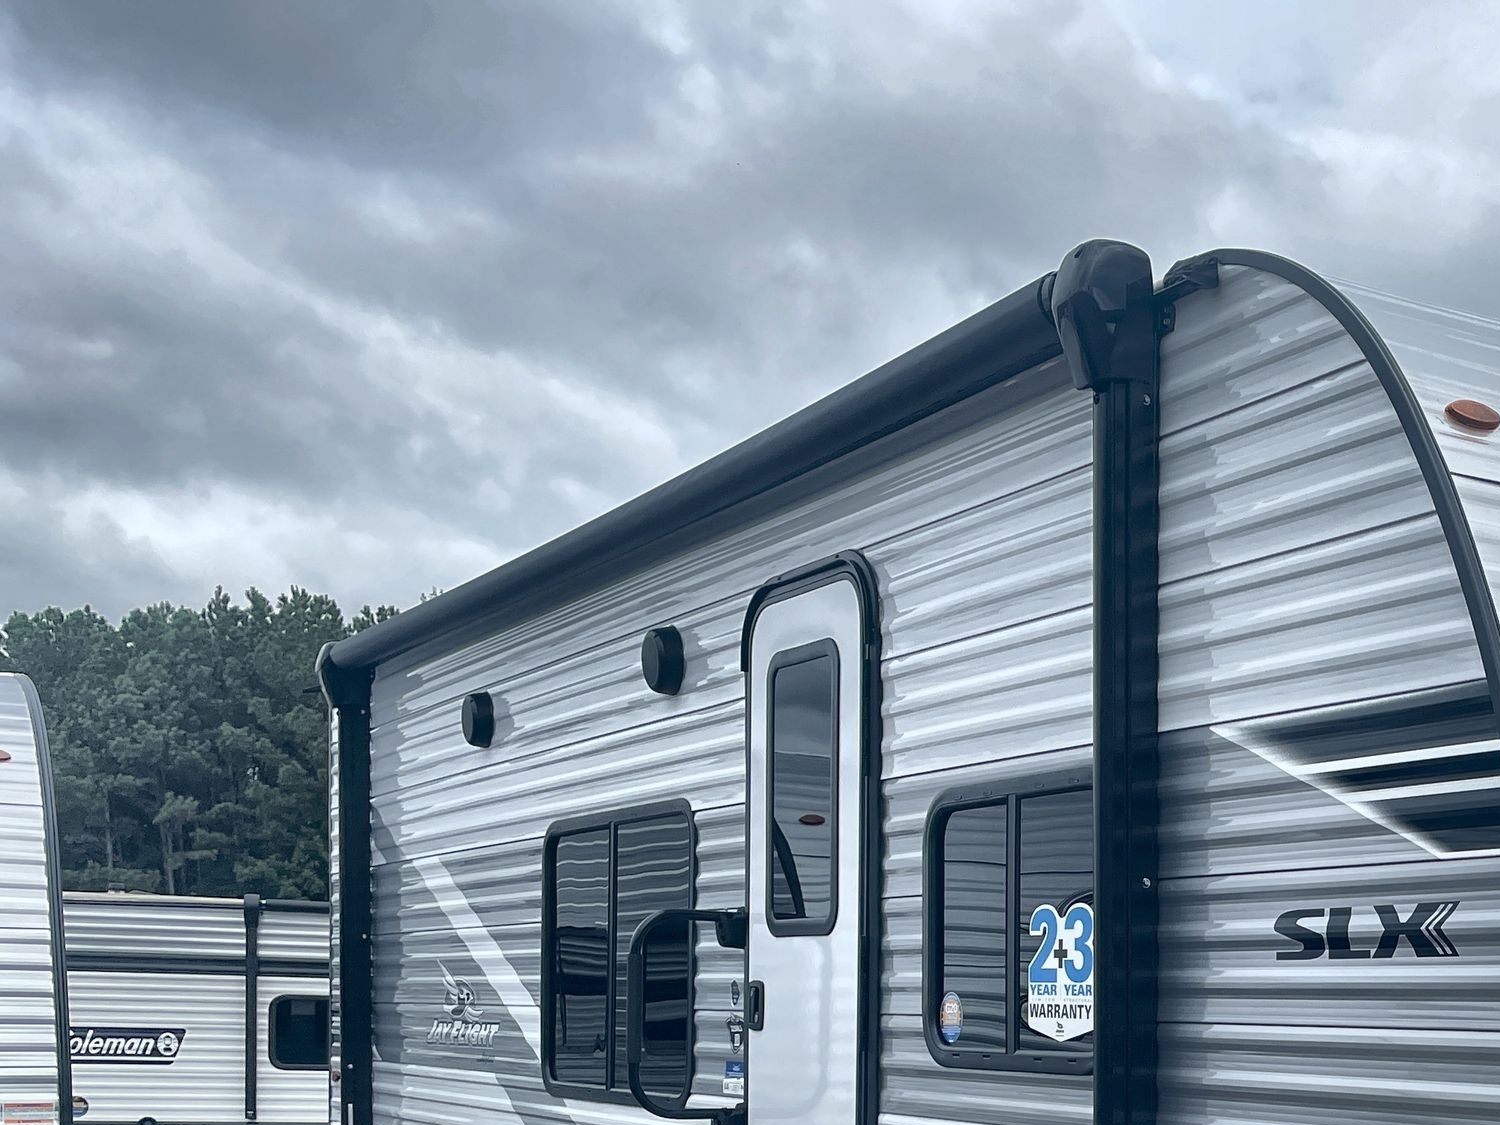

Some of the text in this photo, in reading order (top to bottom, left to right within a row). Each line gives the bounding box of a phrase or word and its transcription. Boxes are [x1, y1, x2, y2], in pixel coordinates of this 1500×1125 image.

[1274, 901, 1460, 960] SLX
[1030, 984, 1092, 997] YEAR YEAR
[1030, 1003, 1092, 1020] WARRANTY
[70, 1029, 155, 1055] oleman
[427, 1019, 499, 1047] JAY FLIGHT
